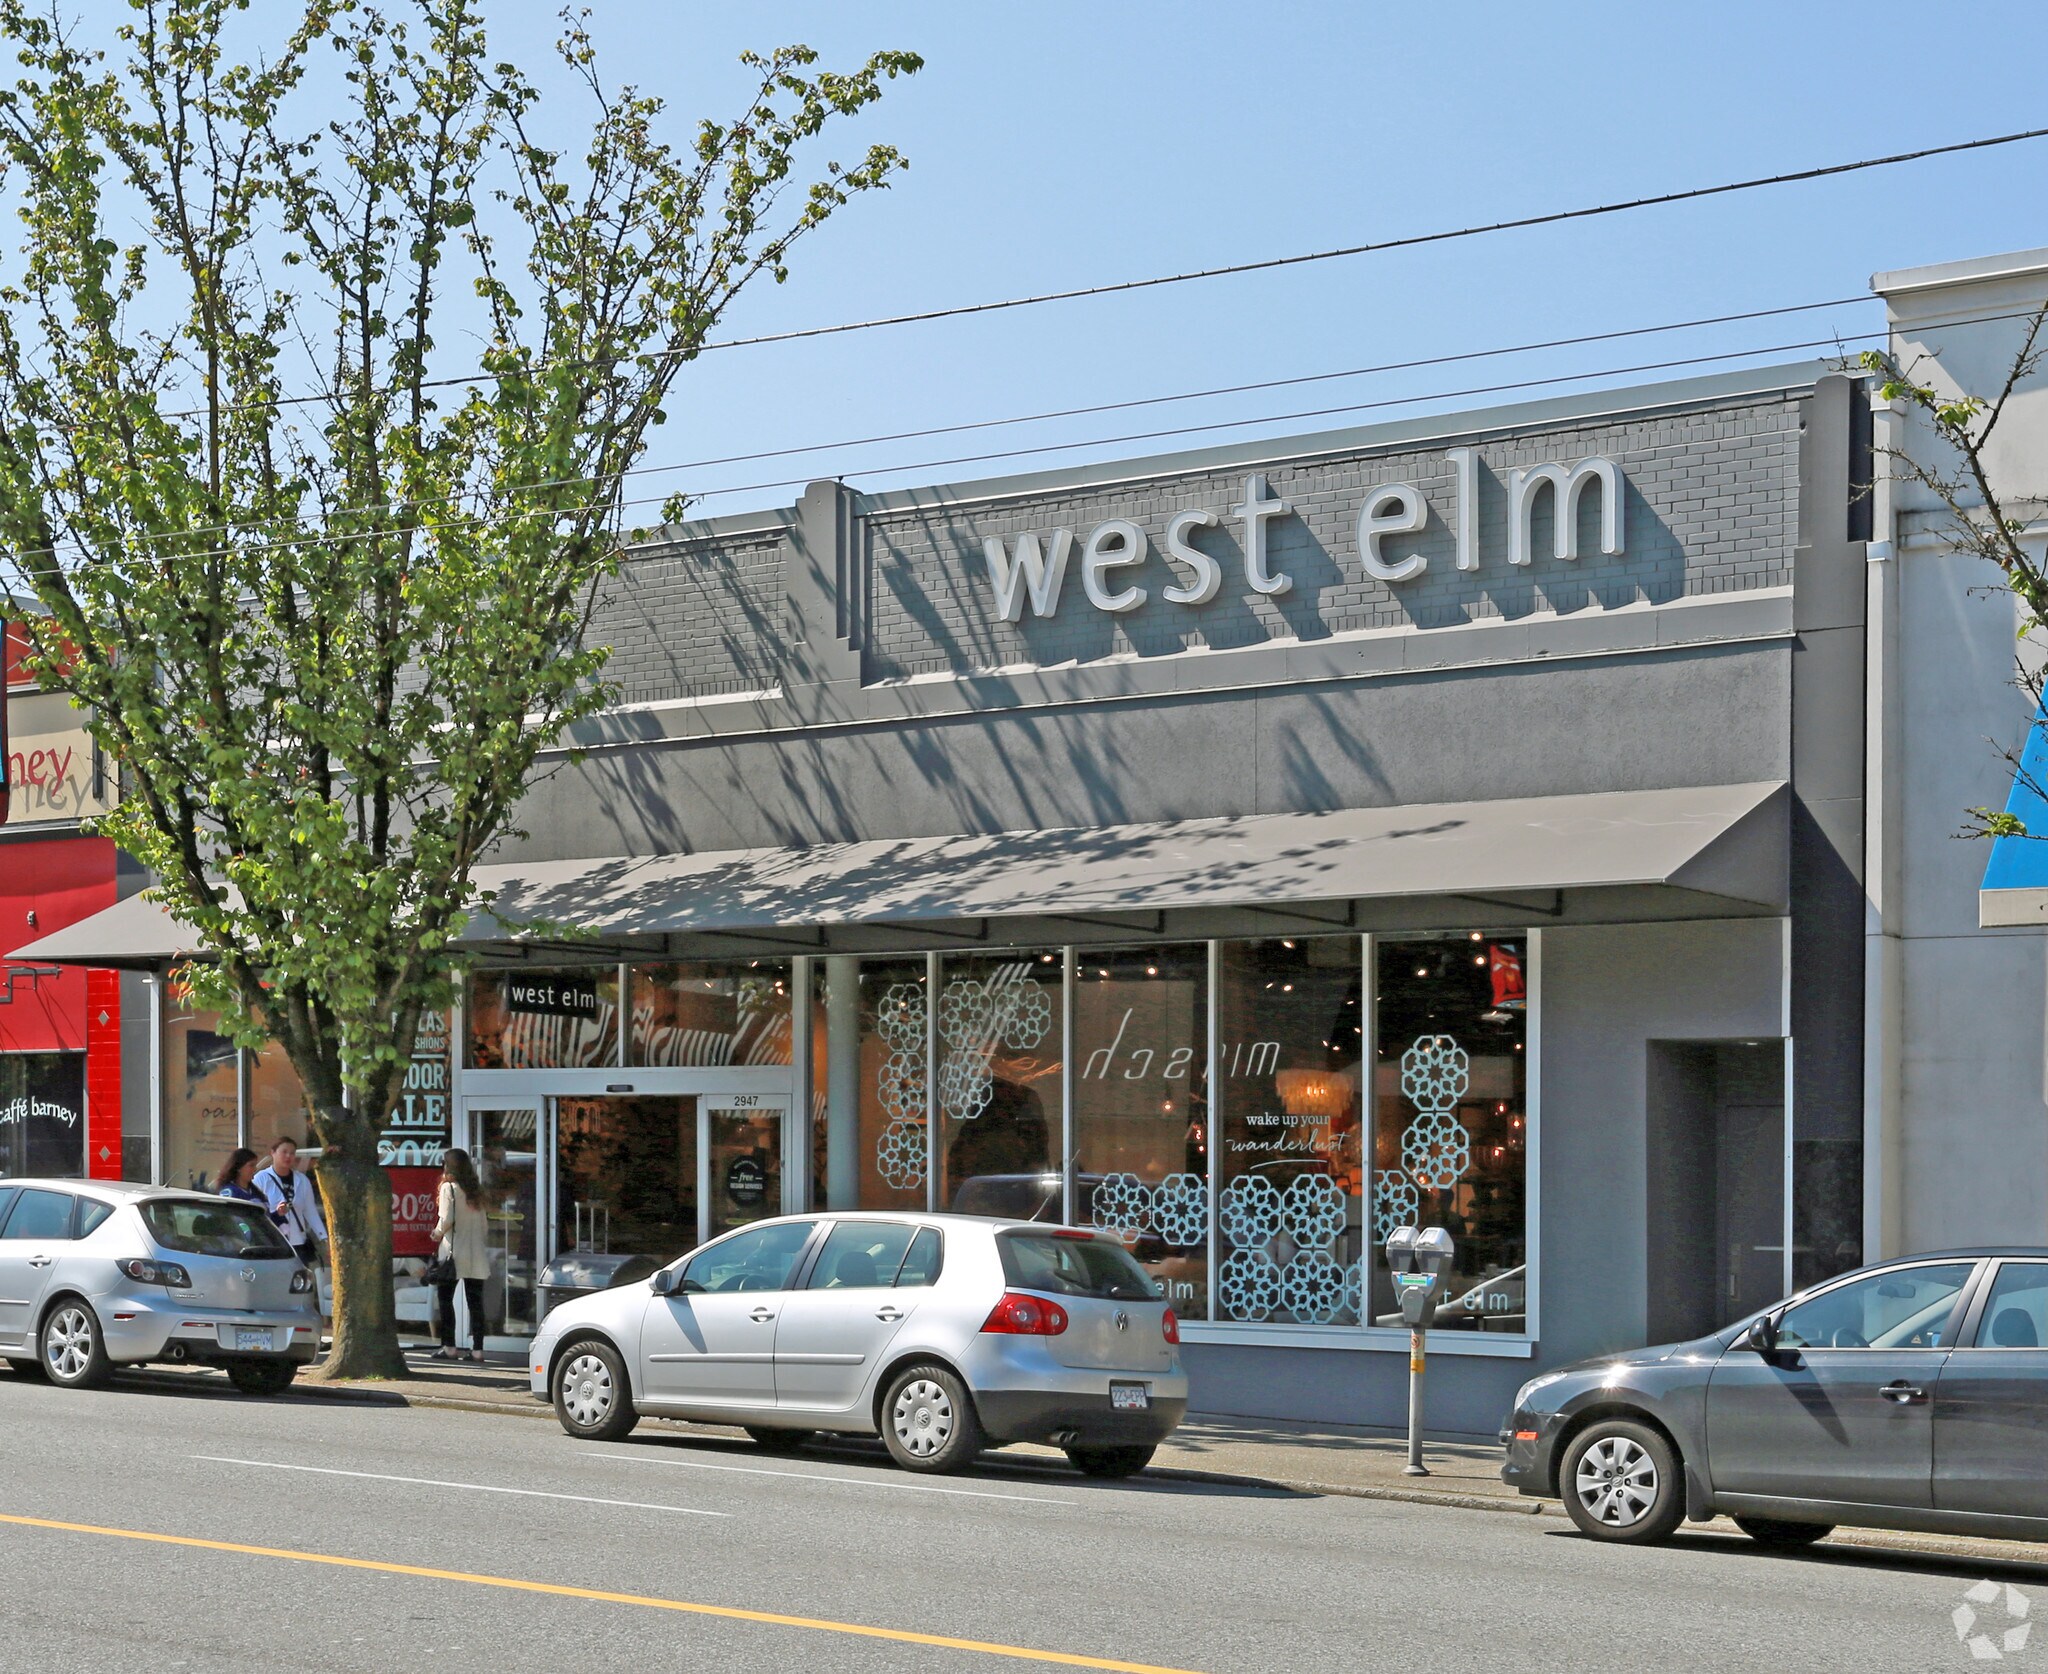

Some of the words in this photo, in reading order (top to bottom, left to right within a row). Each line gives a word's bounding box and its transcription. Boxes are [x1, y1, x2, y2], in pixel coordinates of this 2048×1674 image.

[983, 473, 1292, 622] west
[1356, 447, 1625, 581] elm
[8, 745, 72, 797] ney
[512, 986, 555, 1005] west
[562, 988, 594, 1008] elm
[415, 1037, 446, 1049] SHIONS
[32, 1095, 77, 1128] barney
[734, 1095, 759, 1106] 2947
[1246, 1112, 1280, 1125] wake
[1282, 1115, 1298, 1128] up
[1301, 1115, 1330, 1128] your
[1226, 1128, 1351, 1153] wanderlust
[738, 1172, 754, 1183] free
[392, 1193, 435, 1221] 20%
[1155, 1278, 1194, 1299] elm
[1463, 1288, 1508, 1310] elm
